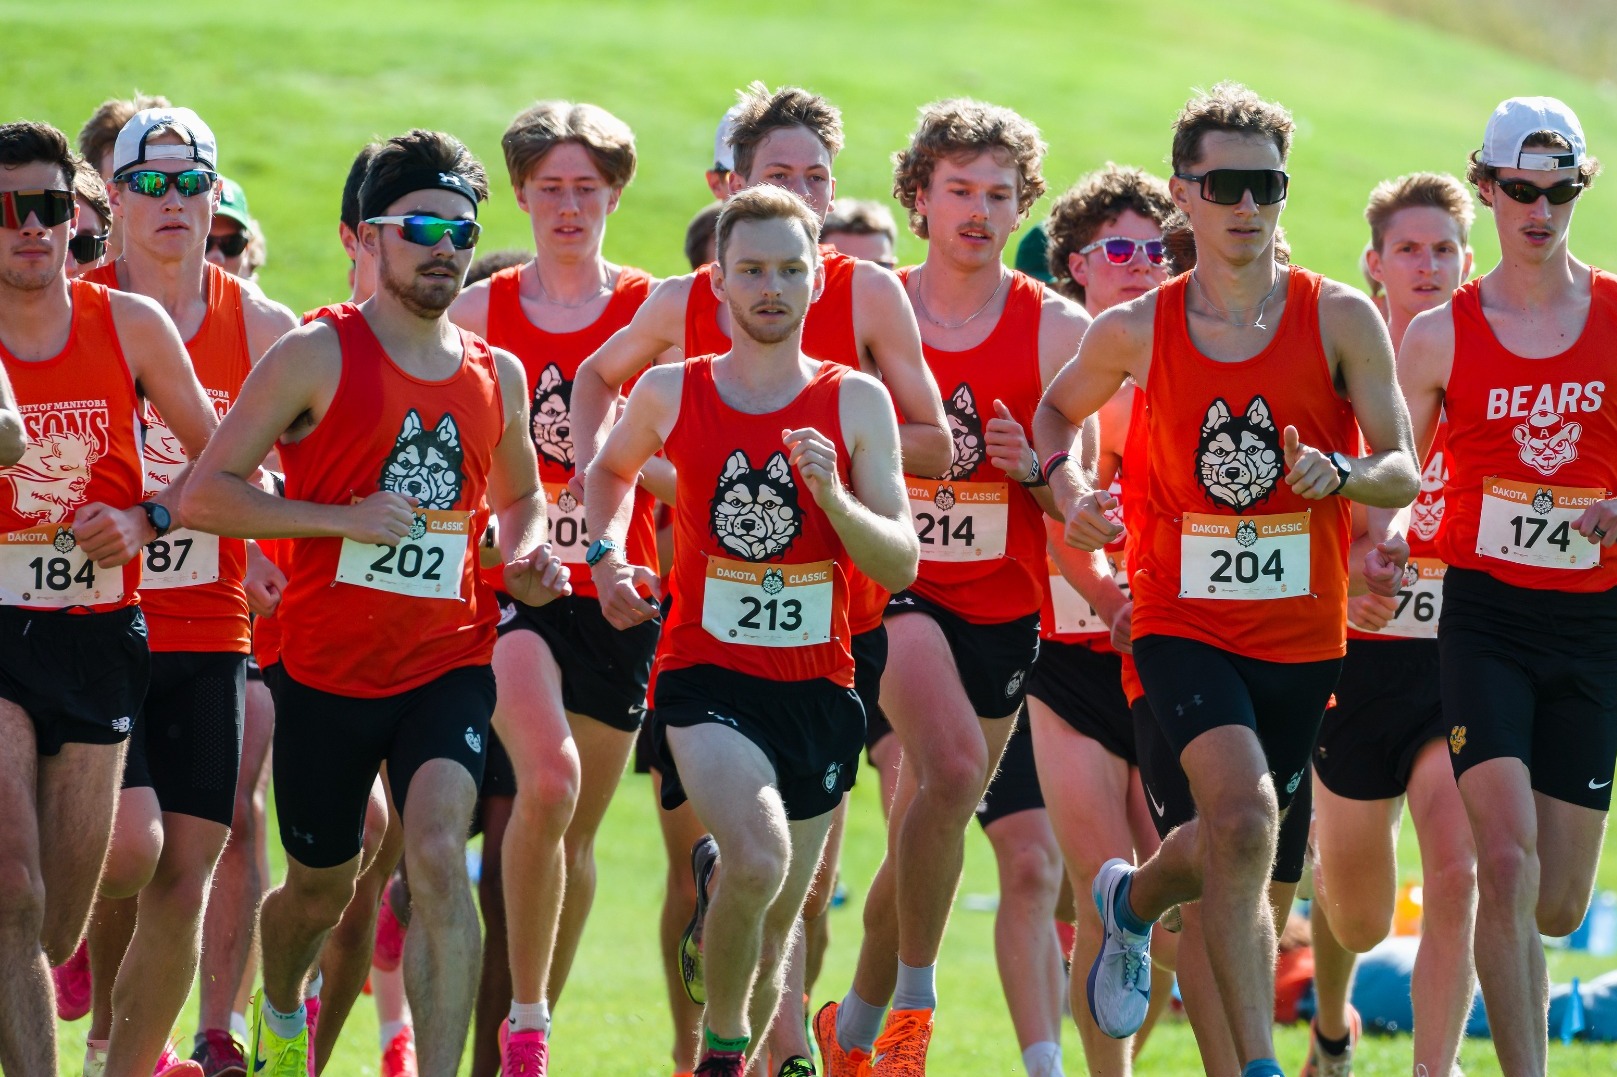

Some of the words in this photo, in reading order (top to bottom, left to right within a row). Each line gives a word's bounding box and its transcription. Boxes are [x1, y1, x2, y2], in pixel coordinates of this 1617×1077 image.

[40, 403, 51, 411] OF
[53, 399, 107, 410] MANITOBA
[1486, 381, 1606, 420] BEARS
[959, 492, 1001, 501] CLASSIC
[1492, 485, 1528, 501] DAKOTA
[7, 532, 49, 542] DAKOTA
[430, 520, 464, 531] CLASSIC
[915, 512, 975, 547] 214
[1191, 523, 1231, 534] DAKOTA
[1262, 522, 1303, 534] CLASSIC
[1510, 515, 1571, 552] 174
[141, 538, 194, 573] 87
[369, 544, 444, 580] 202
[1209, 549, 1285, 584] 204
[28, 557, 95, 591] 184
[716, 567, 757, 582] DAKOTA
[789, 571, 828, 584] CLASSIC
[737, 596, 803, 631] 213
